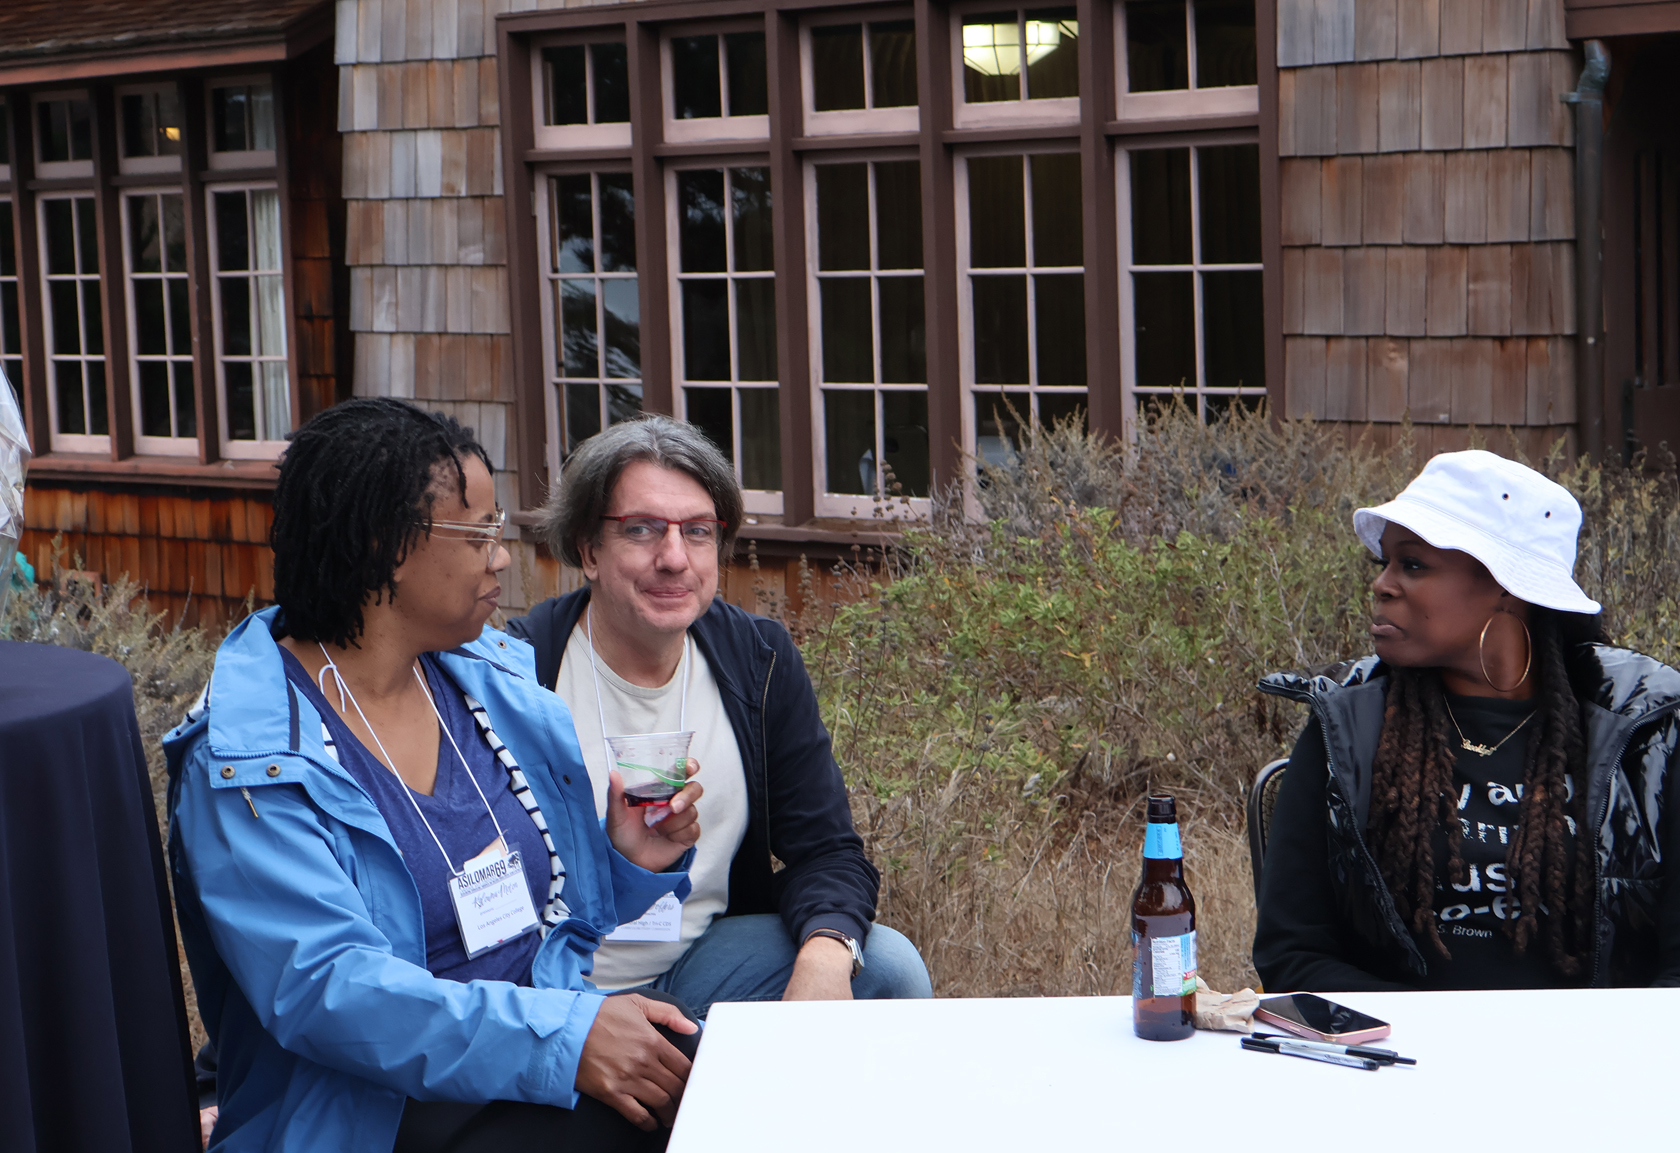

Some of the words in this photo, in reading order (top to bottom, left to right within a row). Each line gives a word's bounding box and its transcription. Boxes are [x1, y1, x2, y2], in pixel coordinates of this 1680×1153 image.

[477, 923, 486, 931] Los
[486, 916, 503, 928] Angeles
[502, 912, 511, 920] City
[510, 905, 525, 915] College
[637, 919, 648, 927] High
[1452, 924, 1494, 939] Brown
